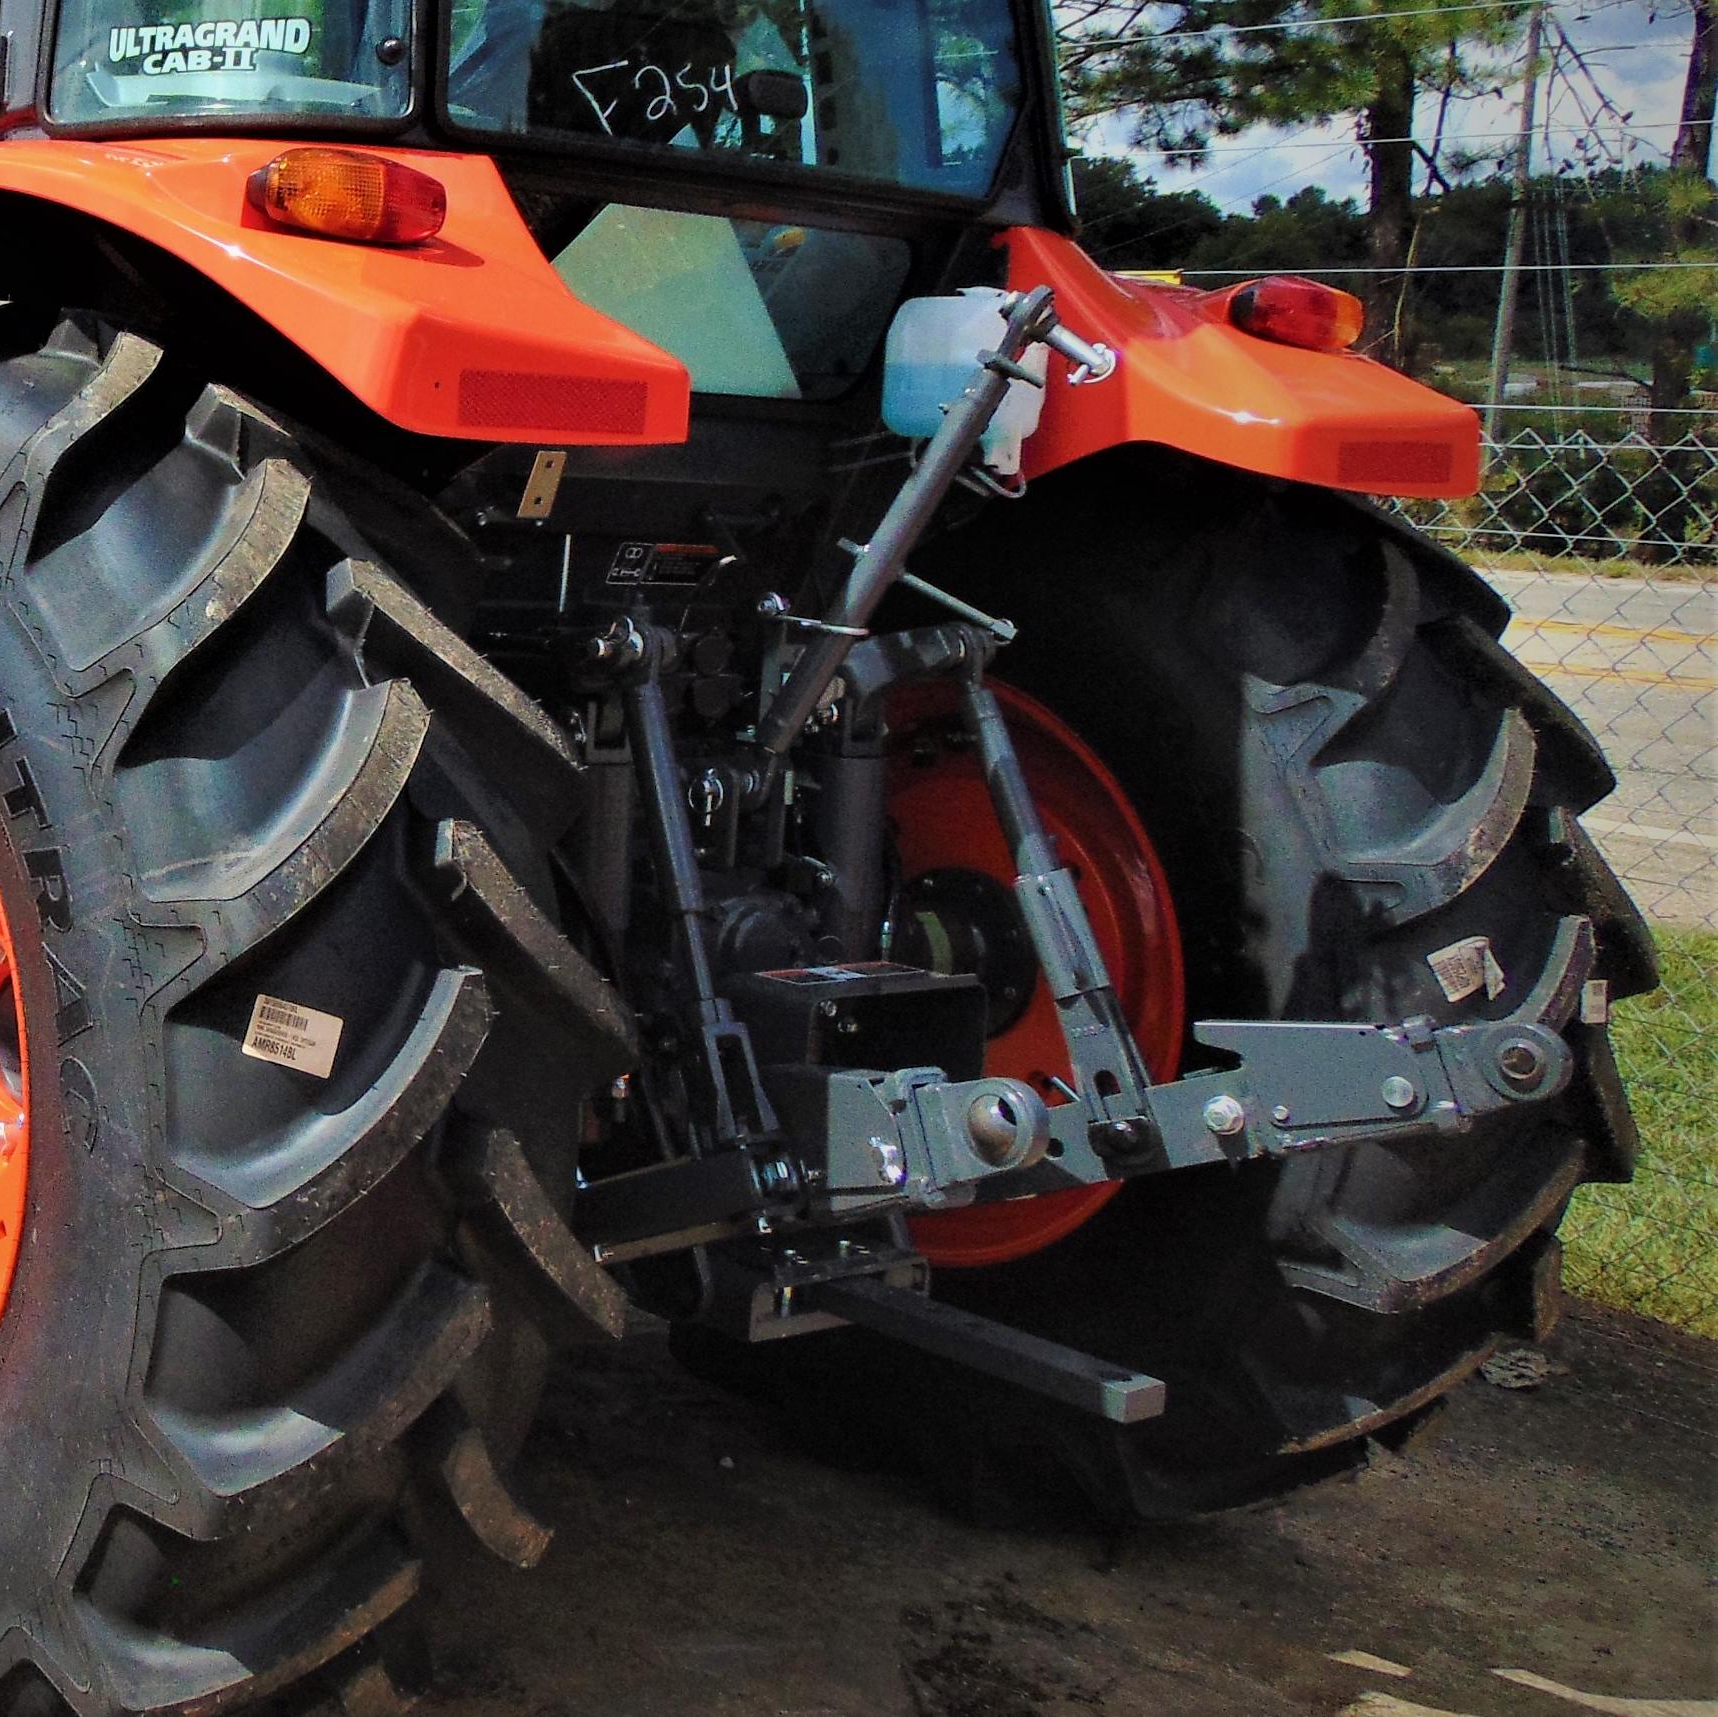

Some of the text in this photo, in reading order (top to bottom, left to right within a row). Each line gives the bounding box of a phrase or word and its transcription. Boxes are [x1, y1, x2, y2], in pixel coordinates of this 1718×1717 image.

[109, 17, 310, 63] ULTRAGRAND
[143, 47, 257, 75] CAB-II
[572, 59, 738, 136] F254
